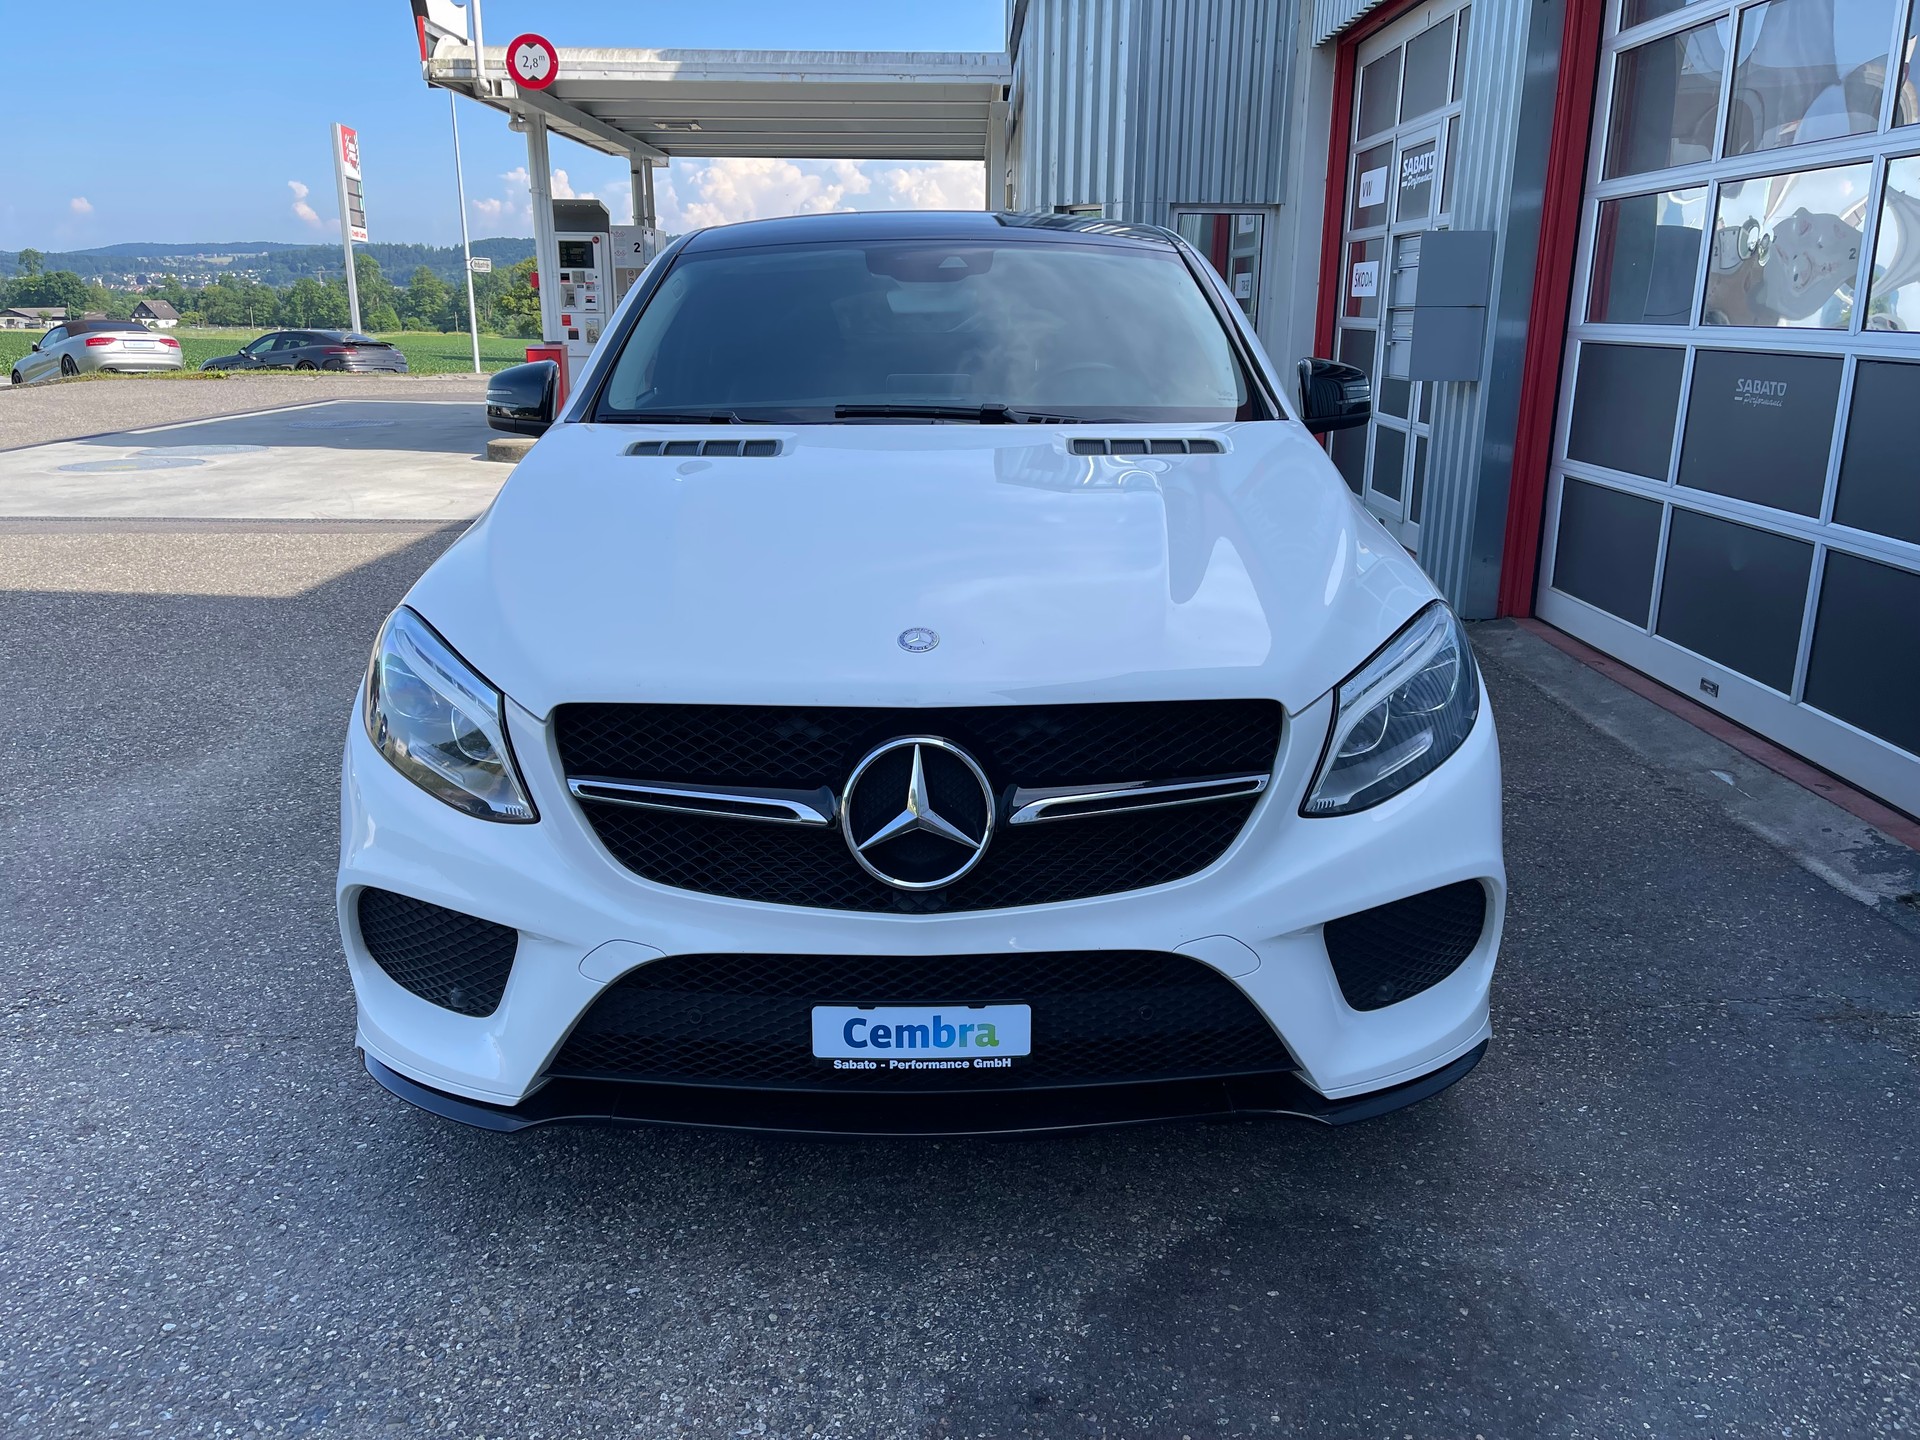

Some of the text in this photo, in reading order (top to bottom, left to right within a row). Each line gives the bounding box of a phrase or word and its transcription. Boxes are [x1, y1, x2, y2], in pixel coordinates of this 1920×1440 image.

[1362, 180, 1372, 197] VW
[633, 242, 641, 253] 2
[1354, 268, 1373, 288] ŠKODA
[1735, 378, 1788, 397] SABATO
[843, 1015, 1000, 1049] Cembra
[833, 1059, 877, 1070] Sabato
[889, 1059, 970, 1070] Performance
[973, 1058, 1012, 1069] GmbH
